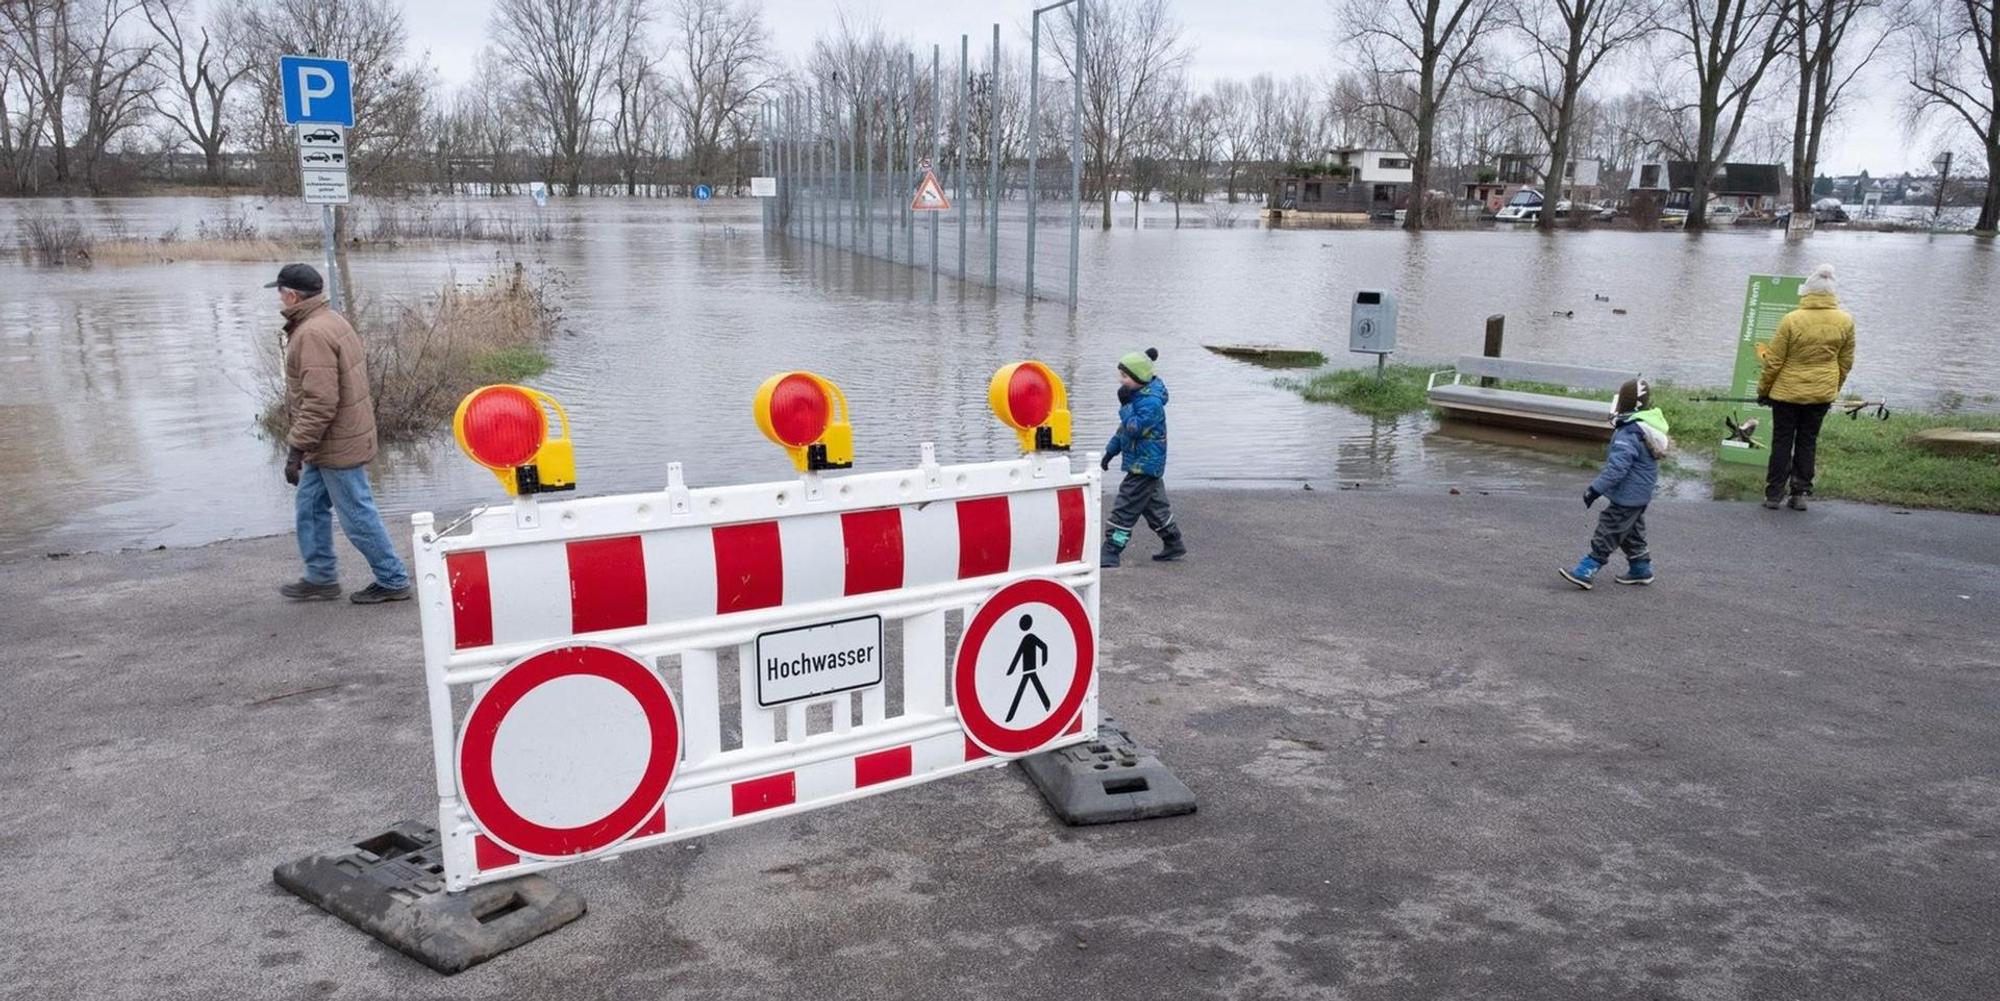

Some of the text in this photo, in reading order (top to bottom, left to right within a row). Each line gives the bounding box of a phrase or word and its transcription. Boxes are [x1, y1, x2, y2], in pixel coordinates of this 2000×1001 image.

[298, 66, 335, 116] P
[1750, 281, 1760, 306] Werth
[767, 646, 874, 681] Hochwasser
